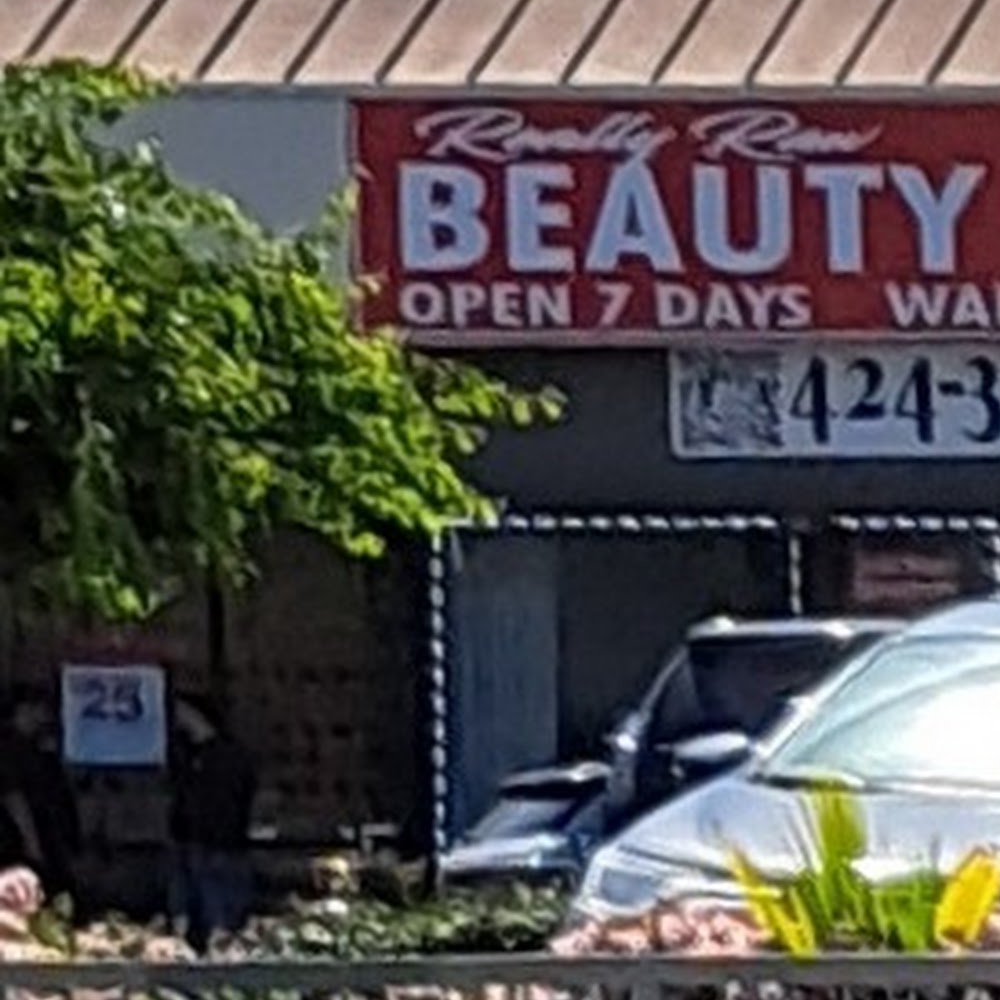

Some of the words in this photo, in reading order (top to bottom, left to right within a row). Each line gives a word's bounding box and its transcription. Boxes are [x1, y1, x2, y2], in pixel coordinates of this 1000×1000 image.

[399, 163, 985, 275] BEAUTY
[401, 283, 571, 326] OPEN
[600, 284, 633, 326] 7
[656, 284, 812, 327] DAYS
